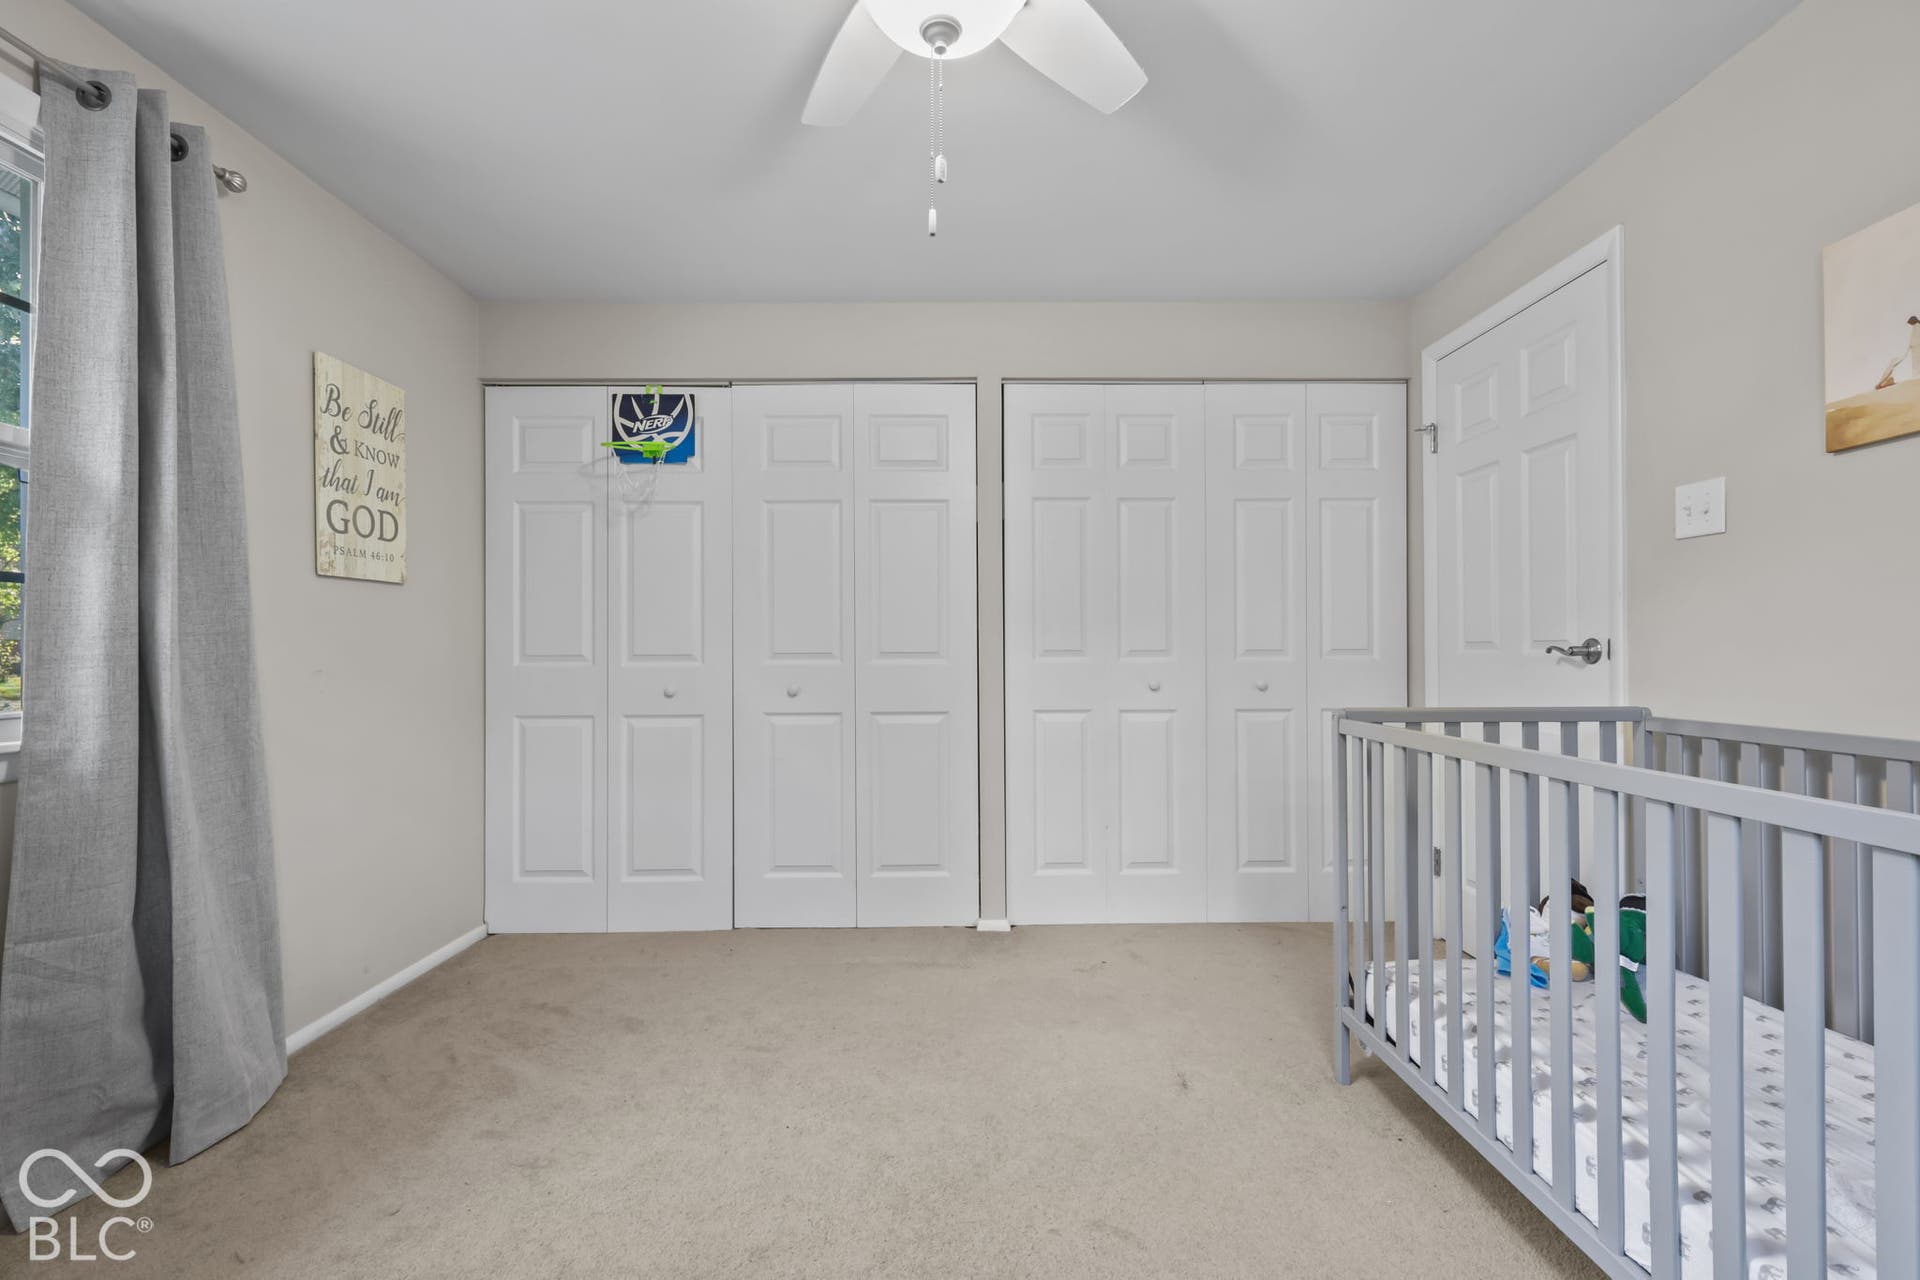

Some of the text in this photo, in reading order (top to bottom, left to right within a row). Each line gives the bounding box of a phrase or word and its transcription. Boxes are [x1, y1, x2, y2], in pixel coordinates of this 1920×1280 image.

[320, 383, 405, 443] Be Still
[632, 416, 673, 433] NERF
[330, 425, 400, 469] & KNOW
[321, 458, 405, 507] that I am
[326, 499, 399, 543] GOD
[333, 546, 395, 562] PSALM 46:10
